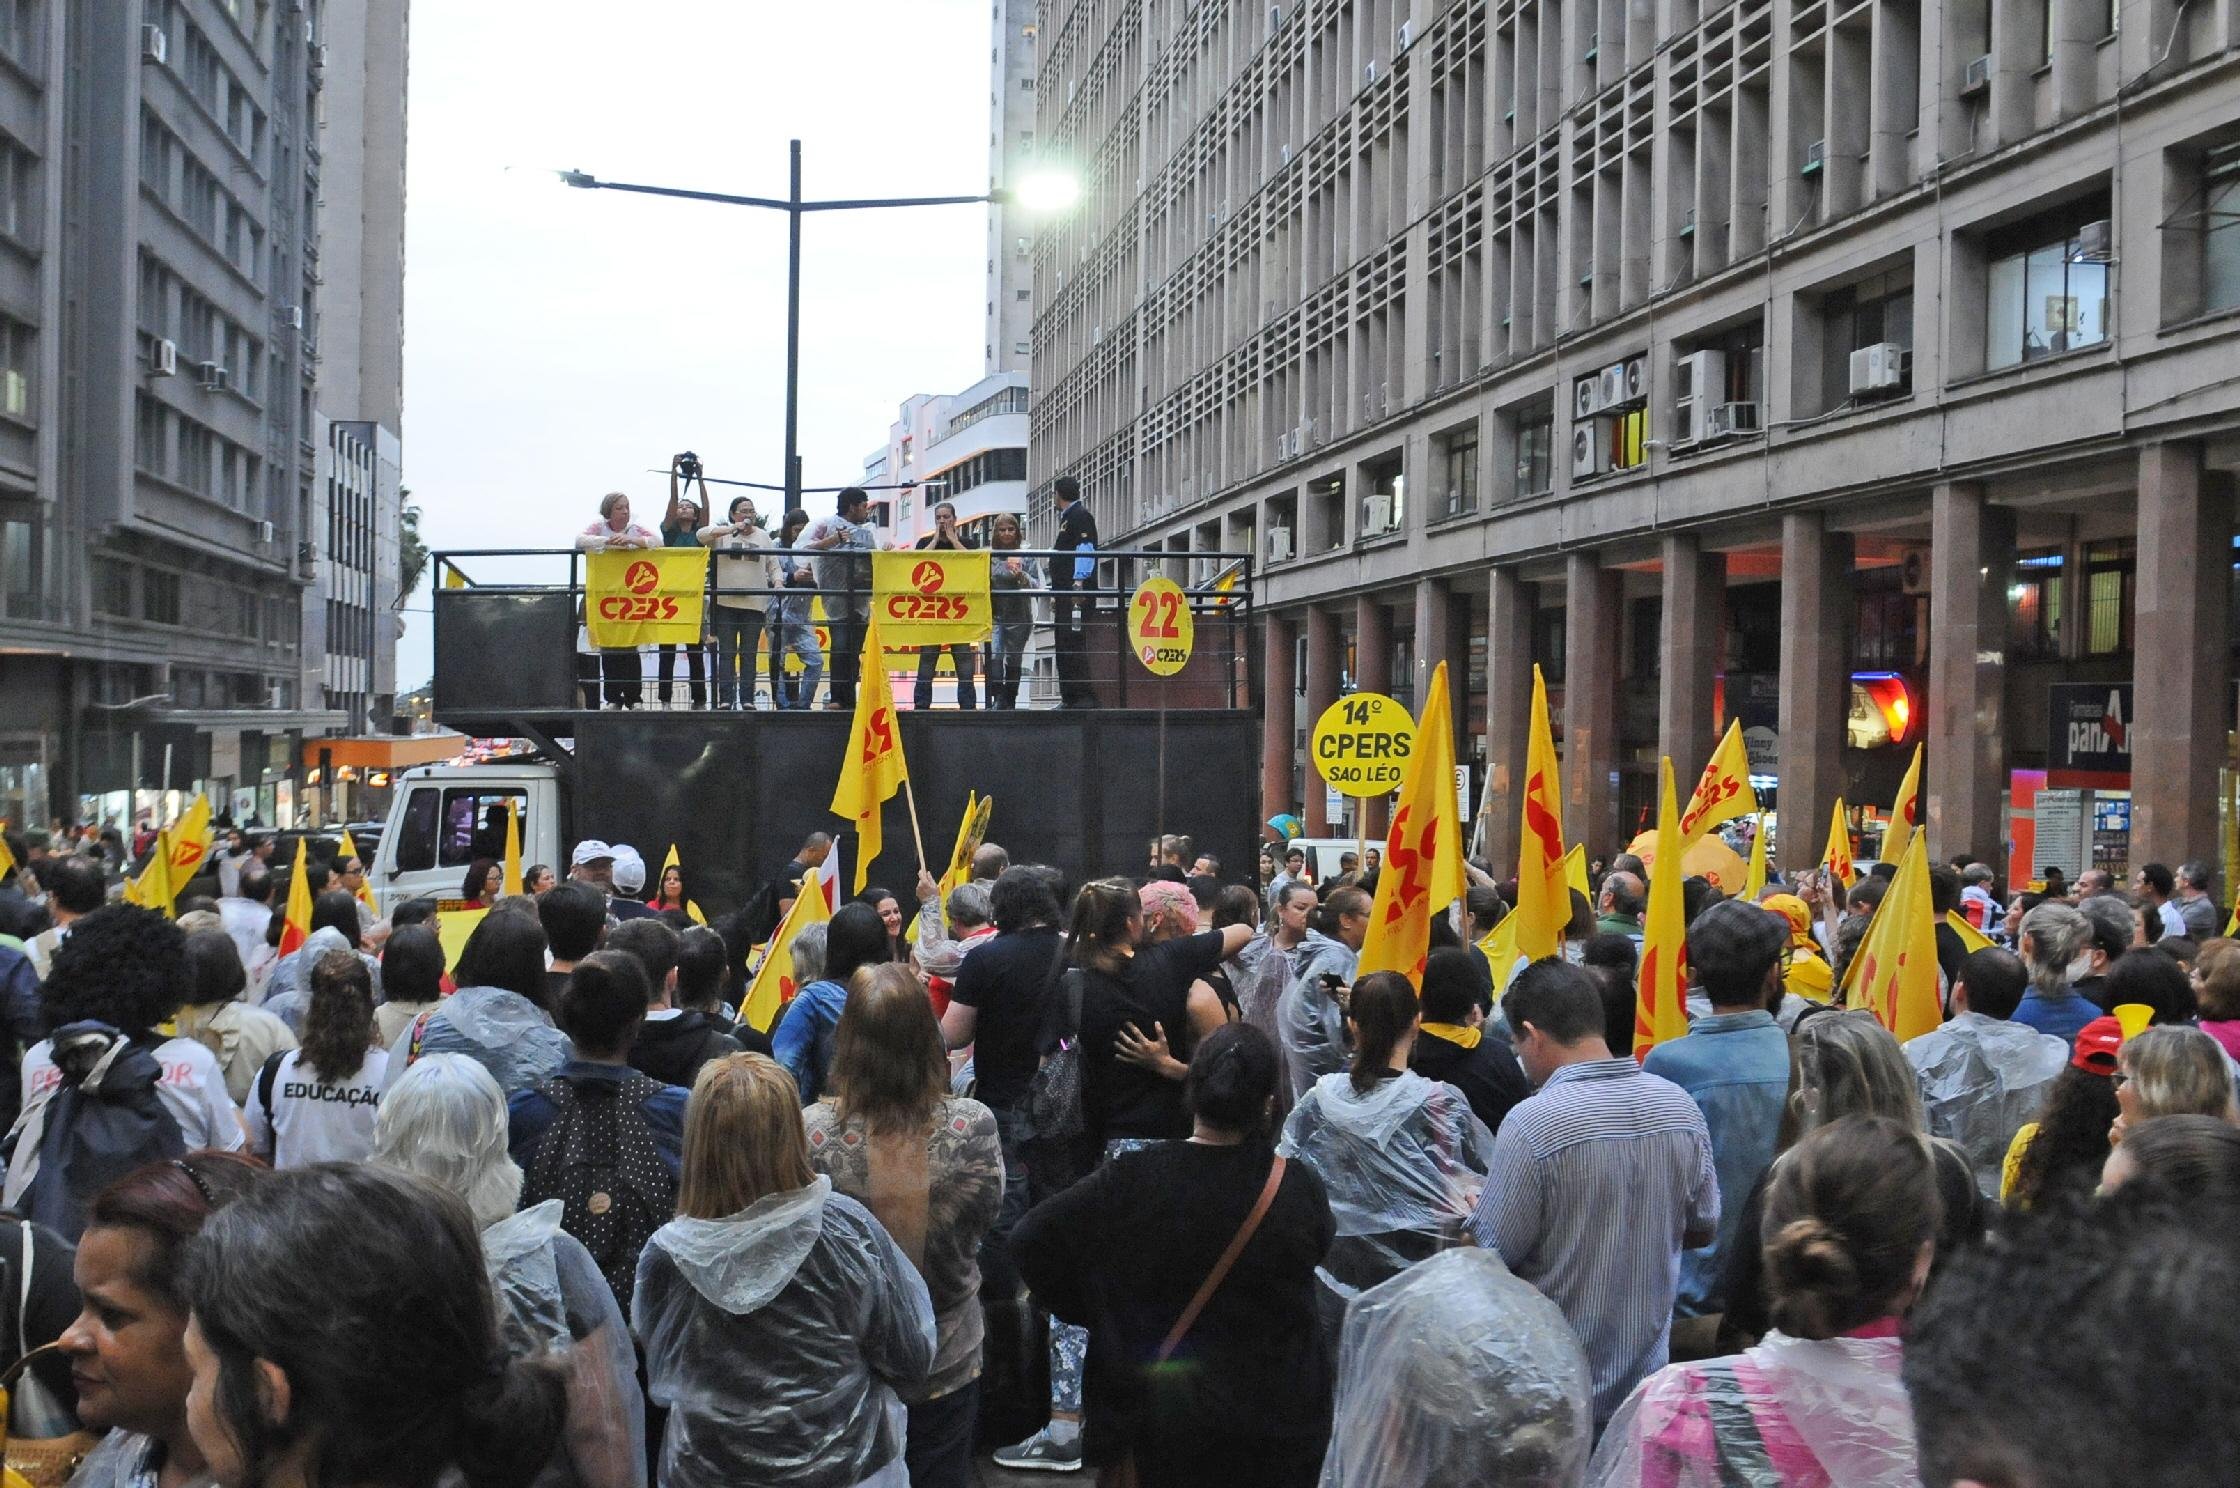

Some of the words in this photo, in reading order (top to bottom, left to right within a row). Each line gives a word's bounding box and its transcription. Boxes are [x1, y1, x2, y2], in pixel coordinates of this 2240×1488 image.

[599, 596, 679, 620] CPERS
[887, 595, 969, 619] CPERS
[1319, 732, 1412, 759] CPERS
